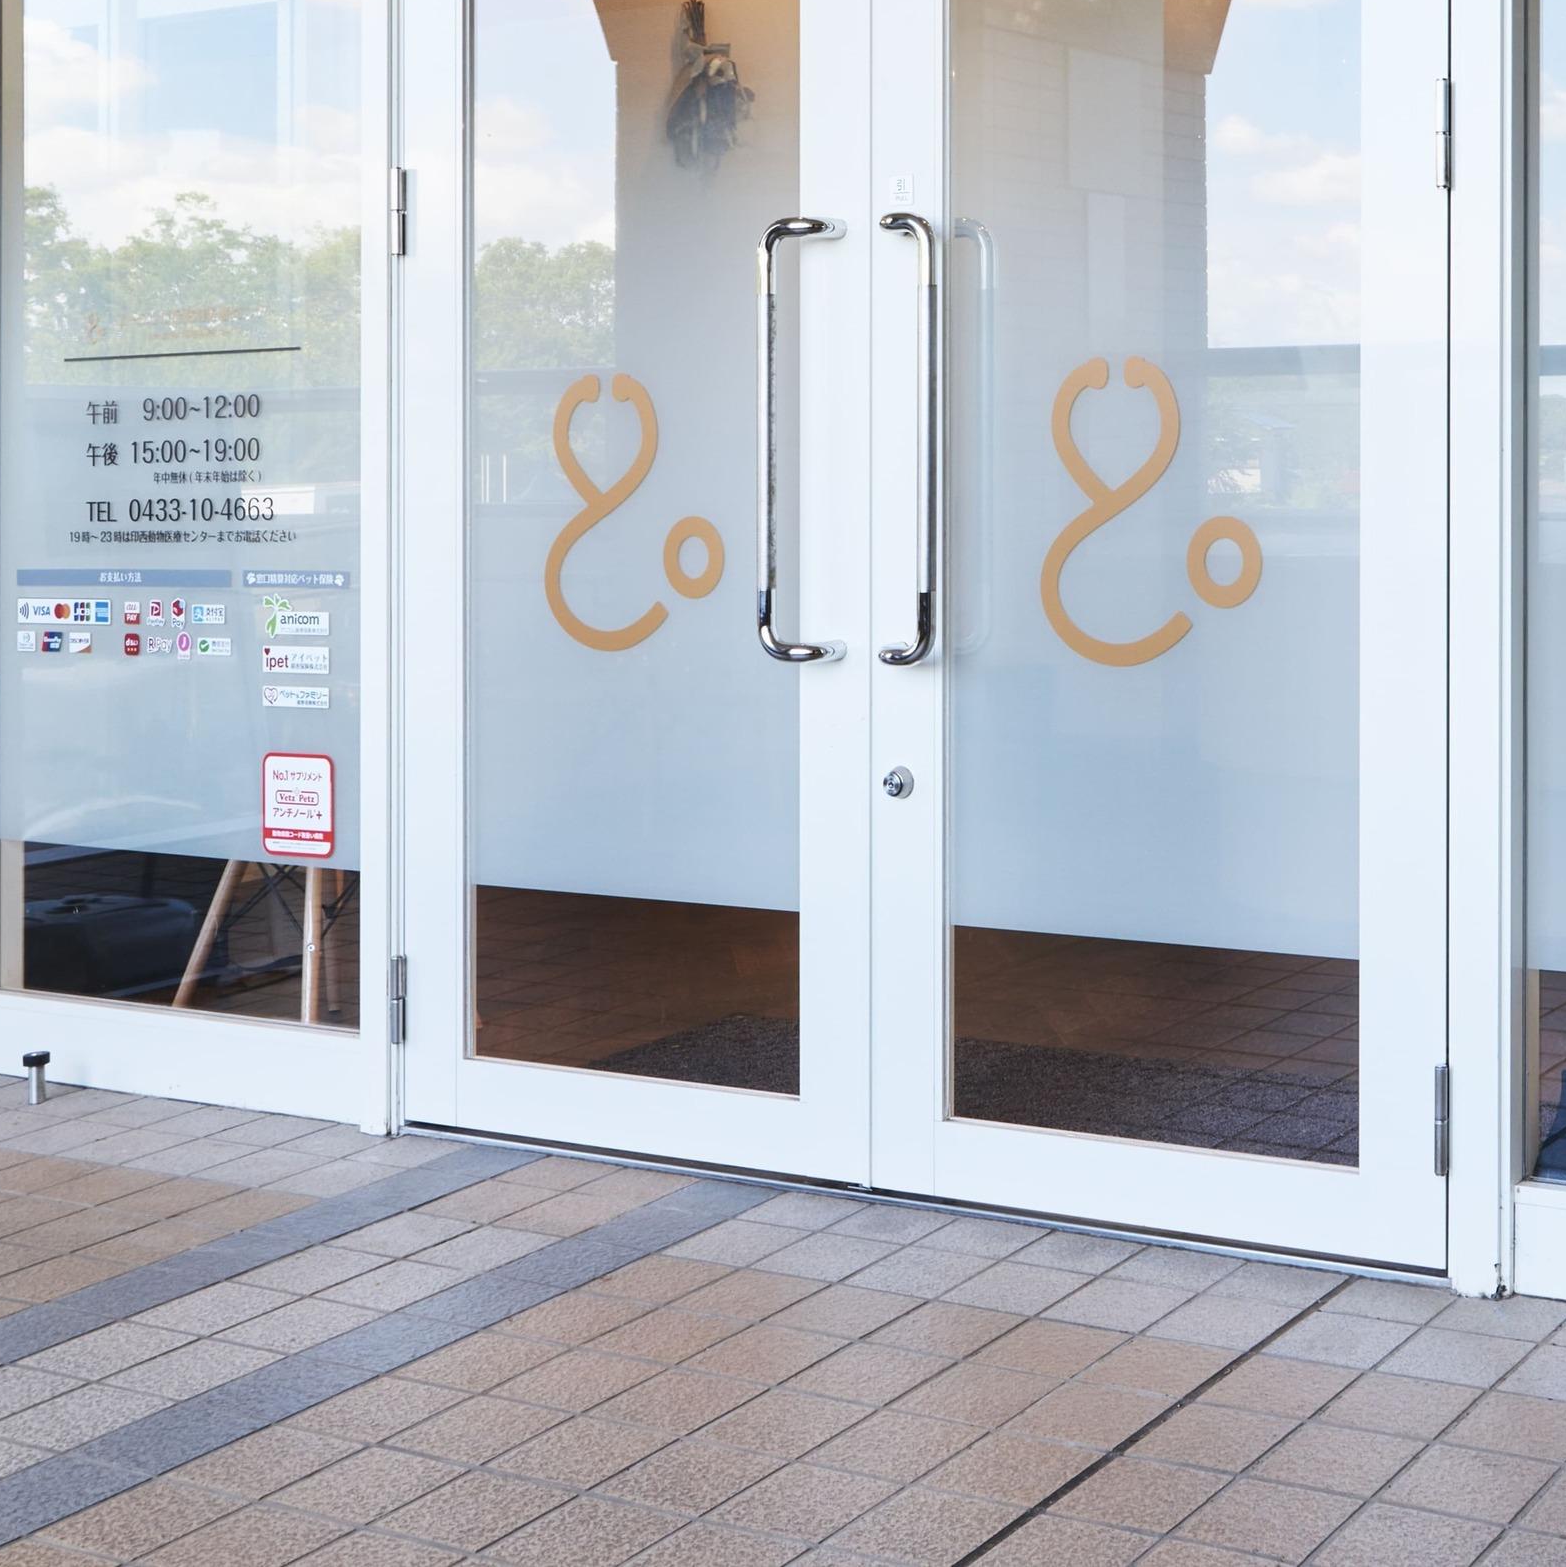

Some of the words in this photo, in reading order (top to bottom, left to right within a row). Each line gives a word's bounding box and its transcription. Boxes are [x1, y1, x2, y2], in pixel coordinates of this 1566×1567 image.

[85, 400, 119, 425] 午前
[85, 442, 119, 468] 午後
[86, 501, 118, 523] TEL
[129, 497, 275, 523] 0433-10-4663
[99, 571, 142, 583] お支払い方法
[32, 605, 51, 616] VISA
[280, 614, 320, 626] anicom
[265, 655, 289, 671] ipet
